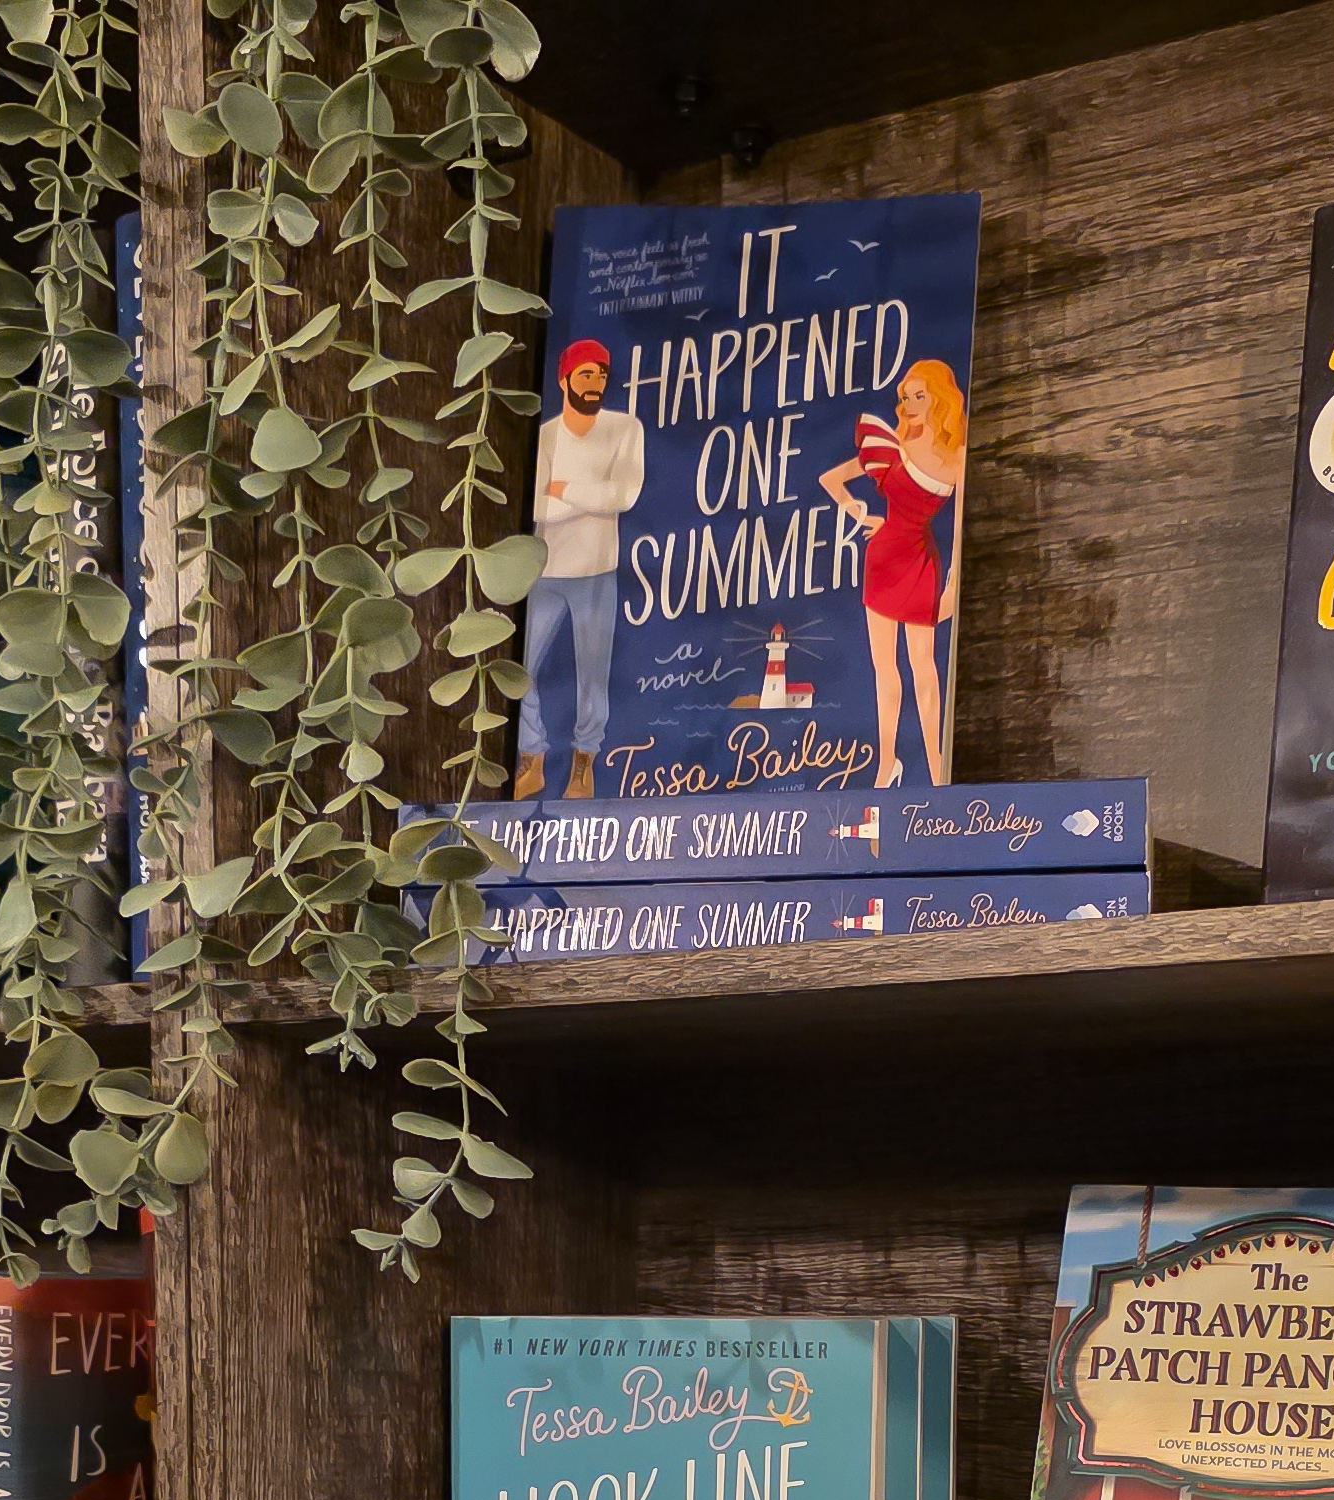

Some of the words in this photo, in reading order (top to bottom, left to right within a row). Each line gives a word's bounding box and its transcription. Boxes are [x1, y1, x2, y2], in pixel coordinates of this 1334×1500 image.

[737, 225, 798, 319] IT
[623, 300, 909, 430] HAPPENED
[696, 414, 805, 516] ONE
[625, 502, 869, 627] SUMMER
[606, 736, 719, 798] Tessa
[728, 721, 875, 789] Bailey
[490, 816, 620, 865] HAPPENED
[625, 816, 678, 862] ONE
[686, 810, 808, 860] SUMMER
[902, 804, 962, 844] Tessa
[963, 799, 1043, 852] Bailey
[1102, 806, 1113, 842] AVON
[1114, 800, 1125, 844] BOOKS
[1250, 1262, 1309, 1293] The
[492, 1339, 516, 1356] #1
[526, 1339, 569, 1358] NEW
[577, 1339, 628, 1358] YORK
[637, 1339, 698, 1358] TIMES
[704, 1339, 830, 1360] BESTSELLER
[1087, 1346, 1231, 1387] PATCH
[506, 1378, 618, 1456] Tessa
[622, 1365, 814, 1451] Bailey
[1158, 1438, 1191, 1451] LOVE
[1195, 1439, 1266, 1454] BLOSSOMS
[1269, 1443, 1284, 1455] IN
[1287, 1445, 1313, 1458] THE
[1181, 1453, 1268, 1470] UNEXPECTED
